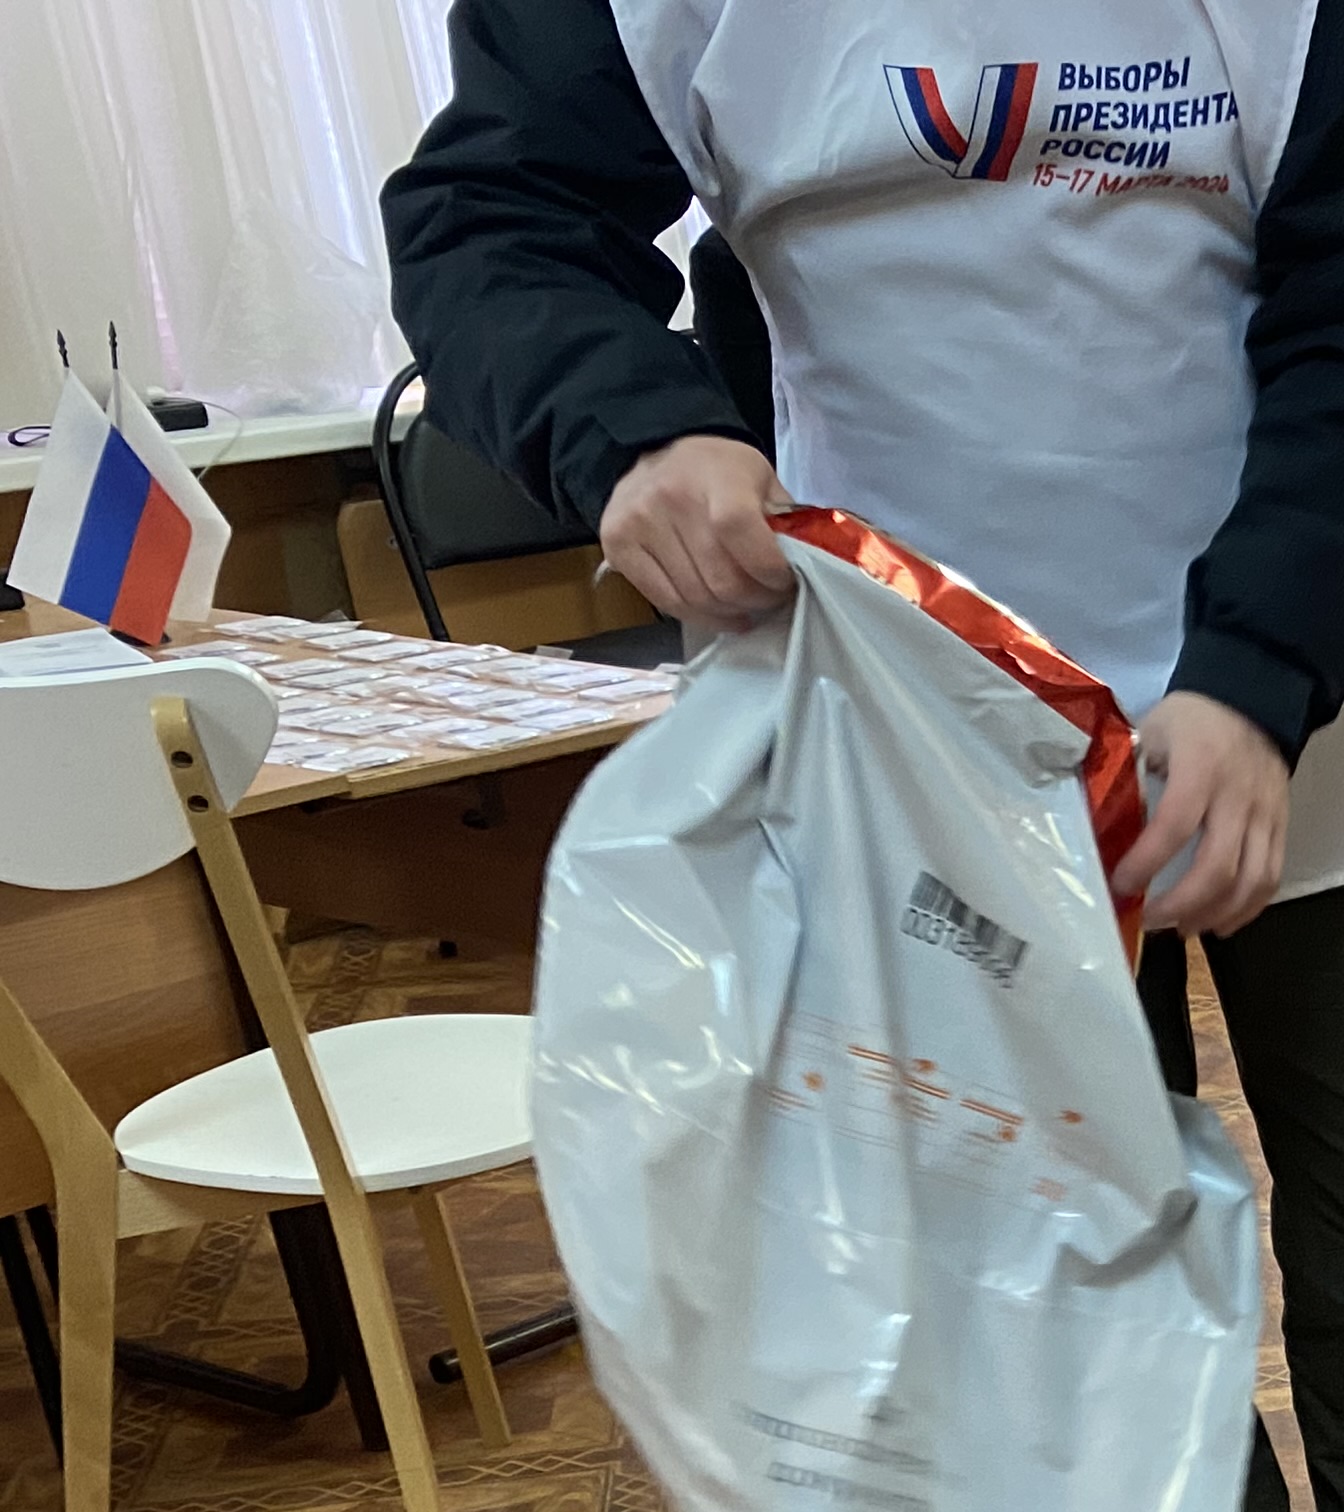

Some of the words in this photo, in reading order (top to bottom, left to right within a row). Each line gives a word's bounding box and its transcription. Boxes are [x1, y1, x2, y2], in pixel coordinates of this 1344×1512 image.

[1058, 56, 1190, 92] ВЫБОРЫ
[1049, 90, 1239, 133] ПРЕЗИДЕНТА
[1039, 138, 1170, 169] РОССИИ
